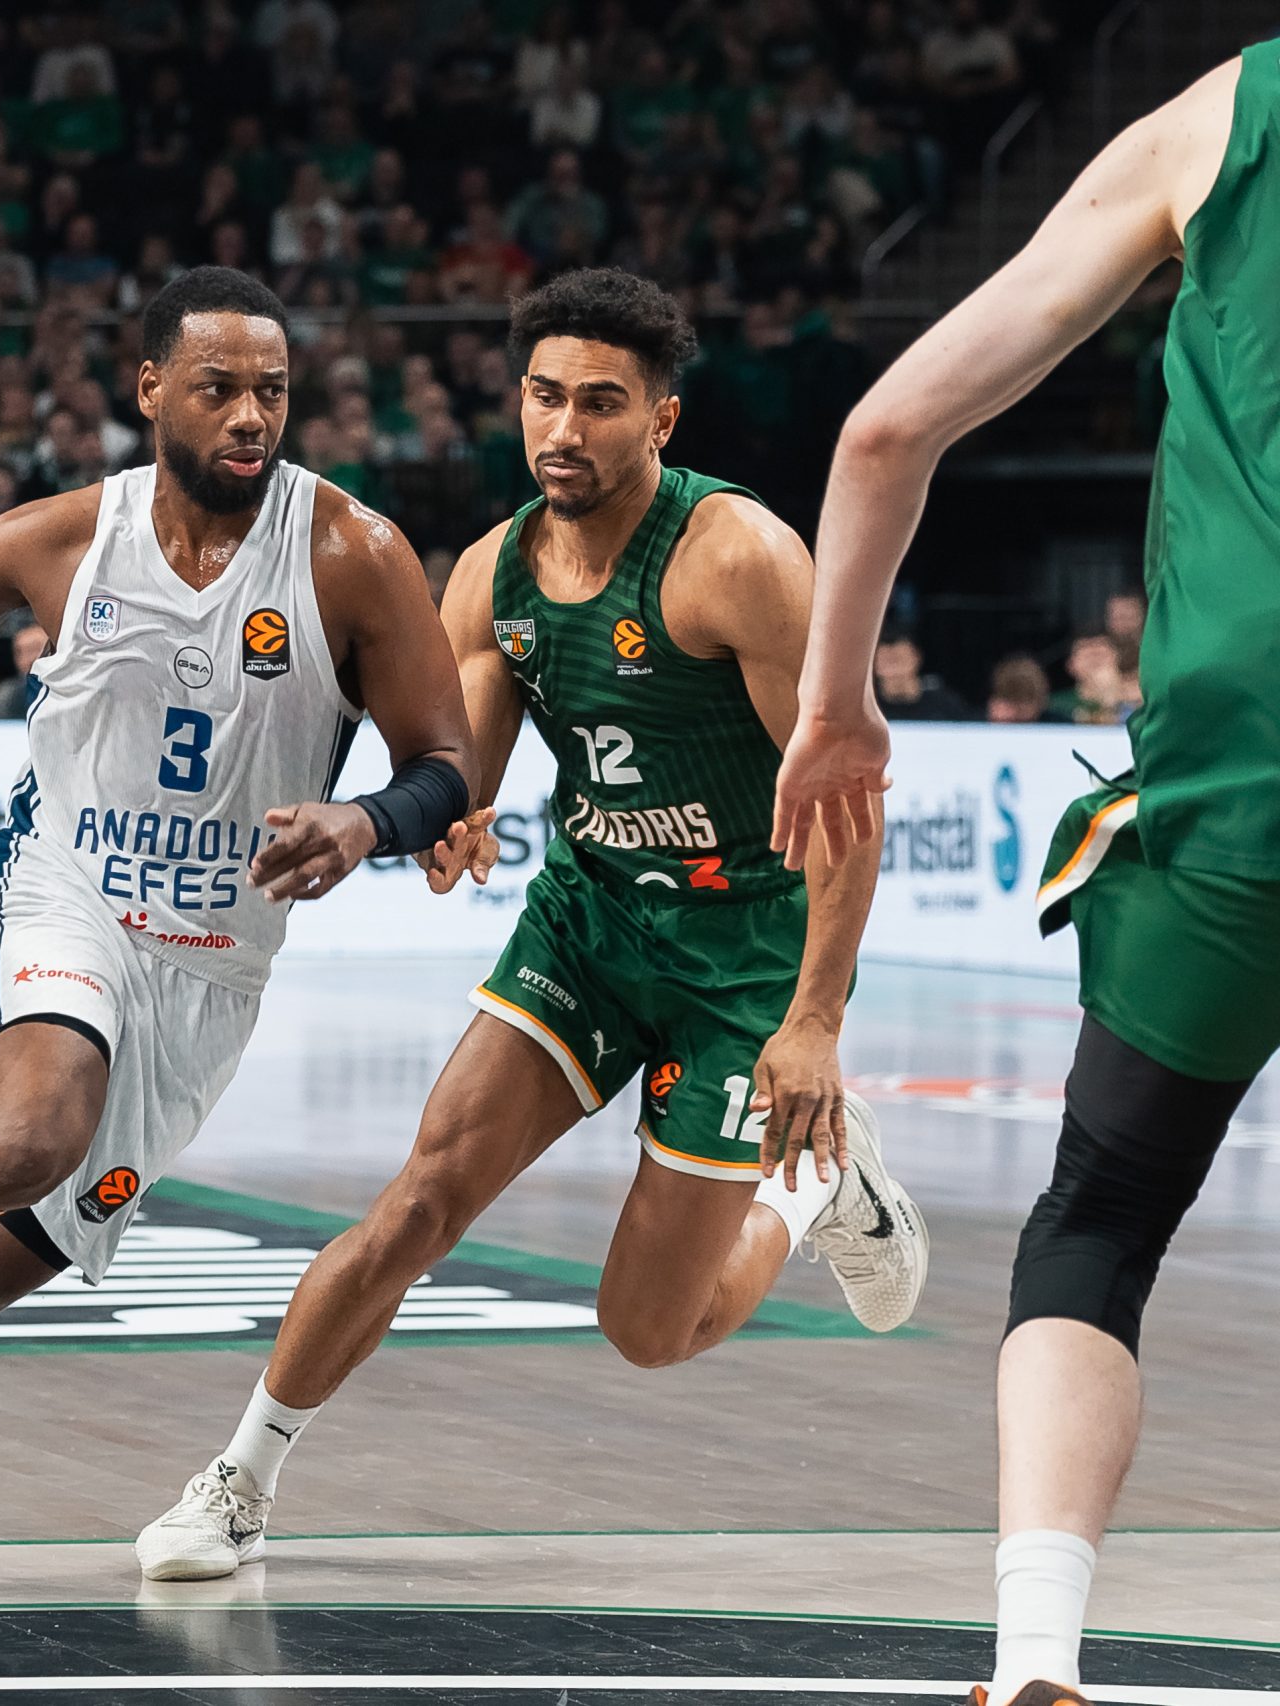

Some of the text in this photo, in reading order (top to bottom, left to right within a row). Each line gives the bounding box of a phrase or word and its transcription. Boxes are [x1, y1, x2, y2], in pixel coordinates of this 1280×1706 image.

[157, 705, 214, 794] 3
[571, 725, 644, 785] 12
[101, 854, 239, 910] EFES
[37, 969, 103, 996] corendon
